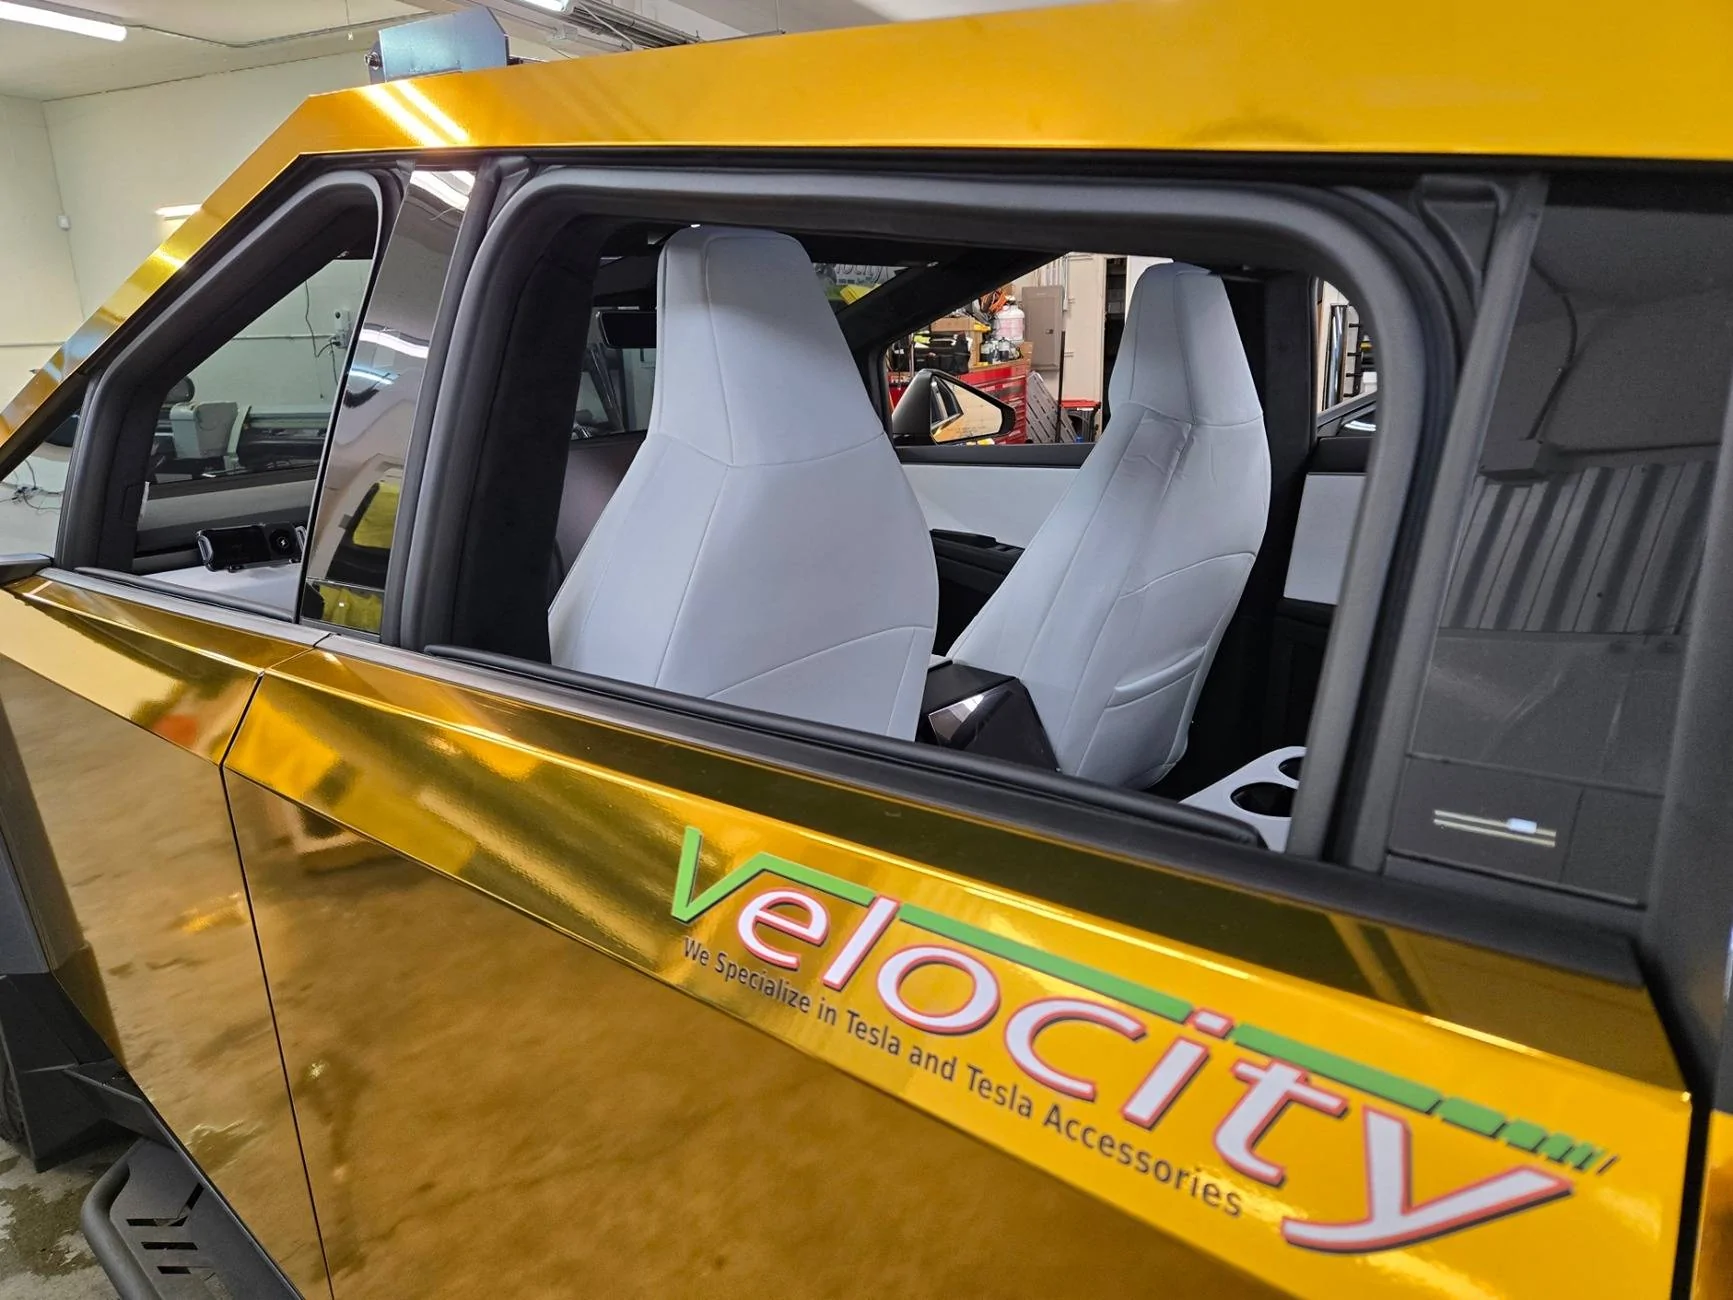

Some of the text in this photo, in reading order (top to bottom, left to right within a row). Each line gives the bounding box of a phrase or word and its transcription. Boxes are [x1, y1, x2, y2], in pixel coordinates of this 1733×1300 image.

[671, 826, 1576, 1254] Velocity
[684, 936, 1243, 1218] We Specialize in Tesla and Tesla Accessories
